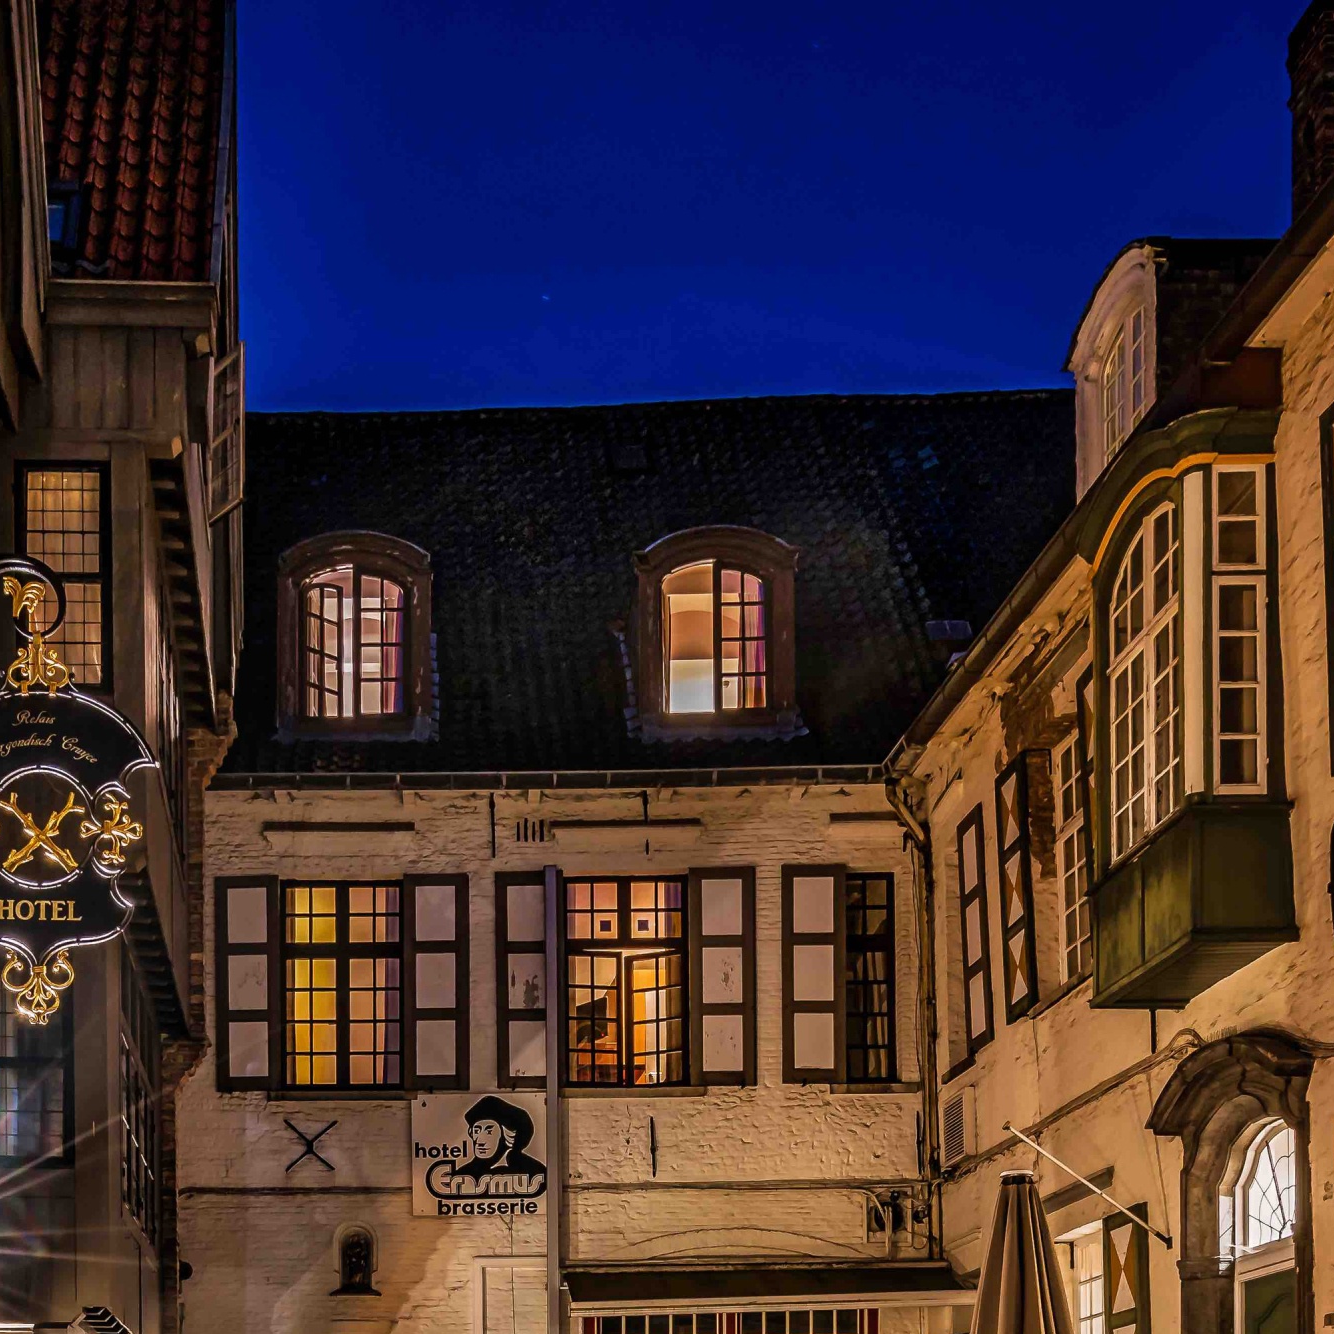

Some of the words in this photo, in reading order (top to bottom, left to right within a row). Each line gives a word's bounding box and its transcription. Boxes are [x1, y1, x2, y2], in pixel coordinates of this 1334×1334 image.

[12, 710, 56, 727] Relais
[62, 735, 98, 764] Cruyce
[414, 1140, 468, 1159] hotel
[430, 1163, 545, 1195] Erasmus
[437, 1198, 538, 1216] brasserie
